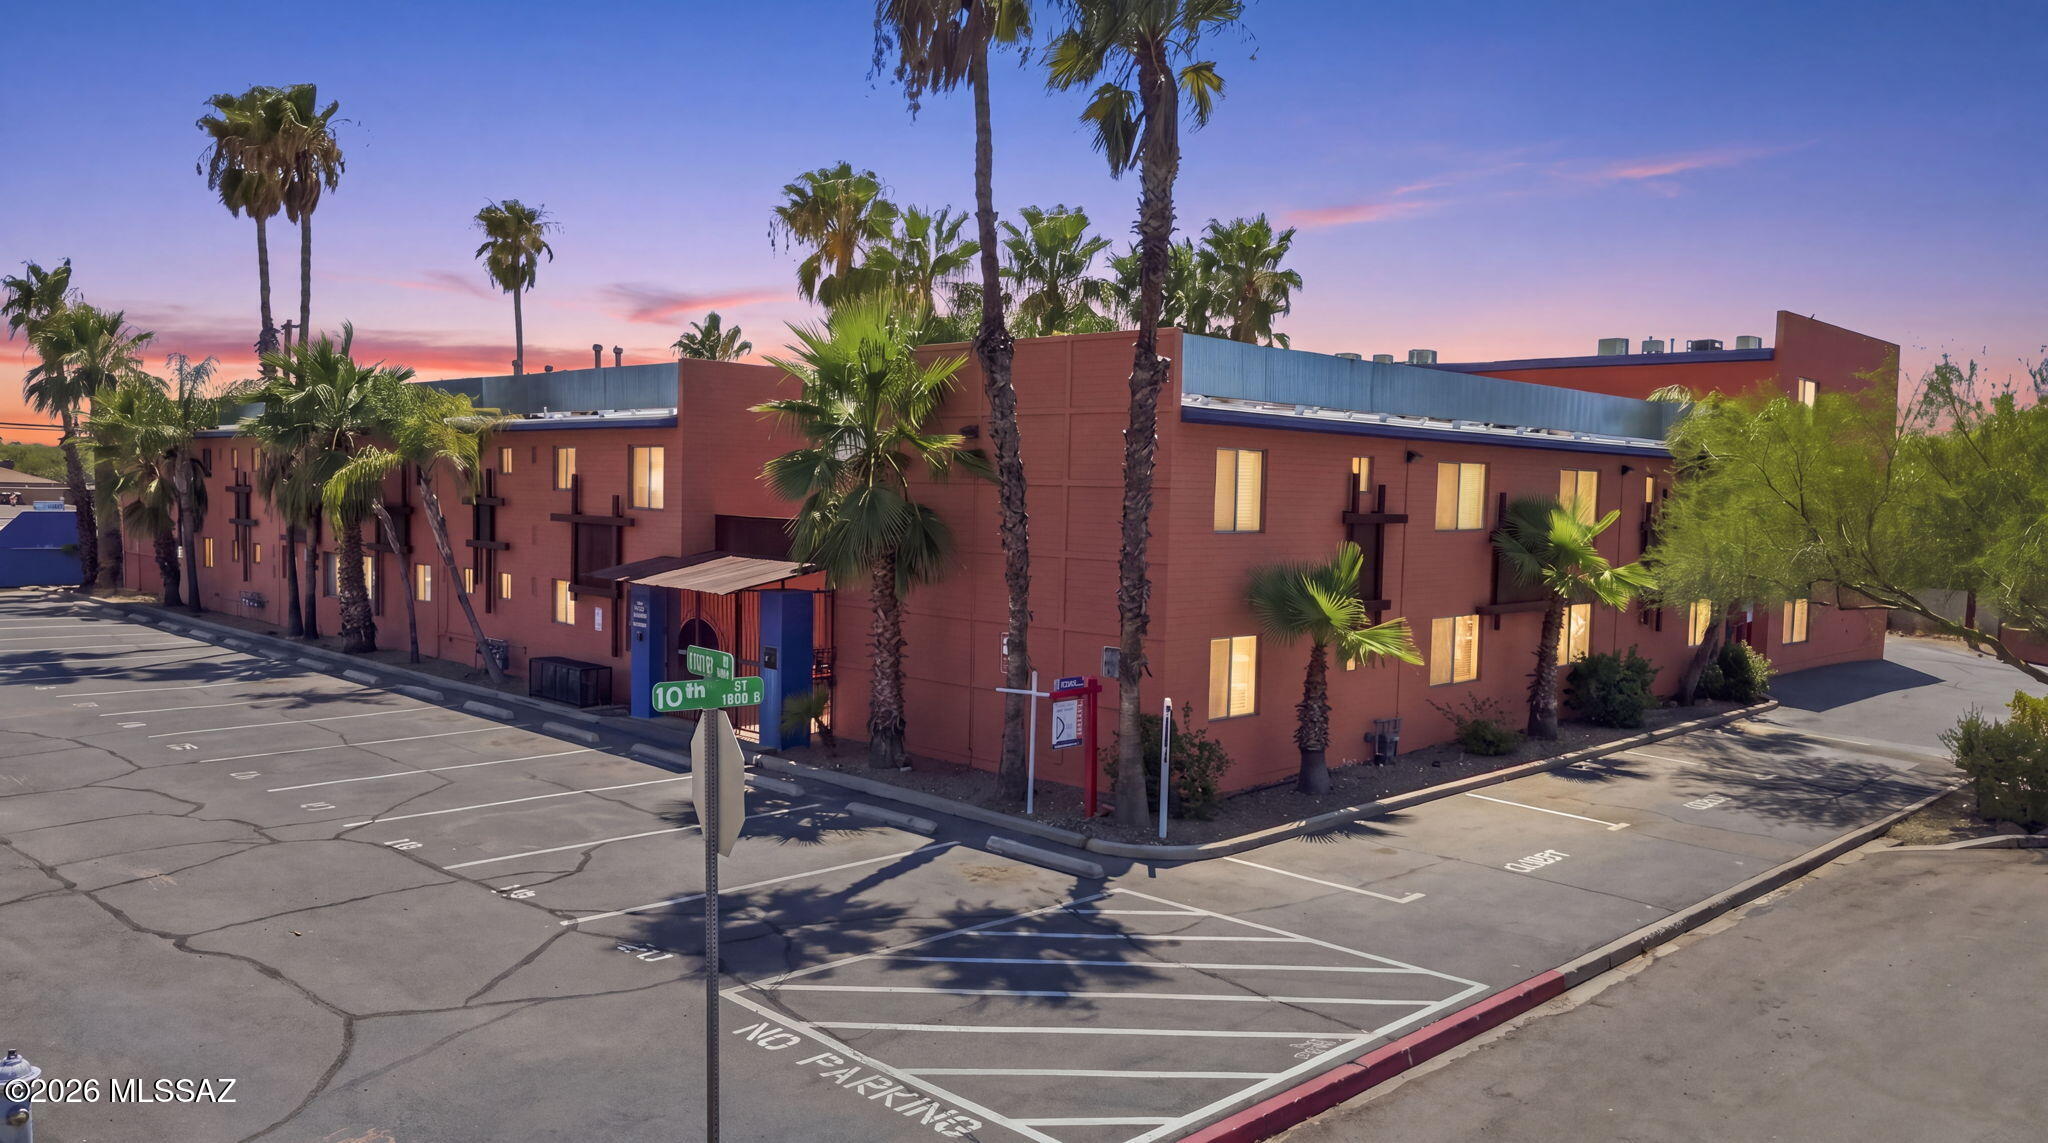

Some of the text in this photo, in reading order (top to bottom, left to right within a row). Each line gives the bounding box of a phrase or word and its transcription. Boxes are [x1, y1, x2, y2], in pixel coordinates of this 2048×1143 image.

[656, 680, 747, 709] 10th ST
[732, 1022, 982, 1137] NO PARKING
